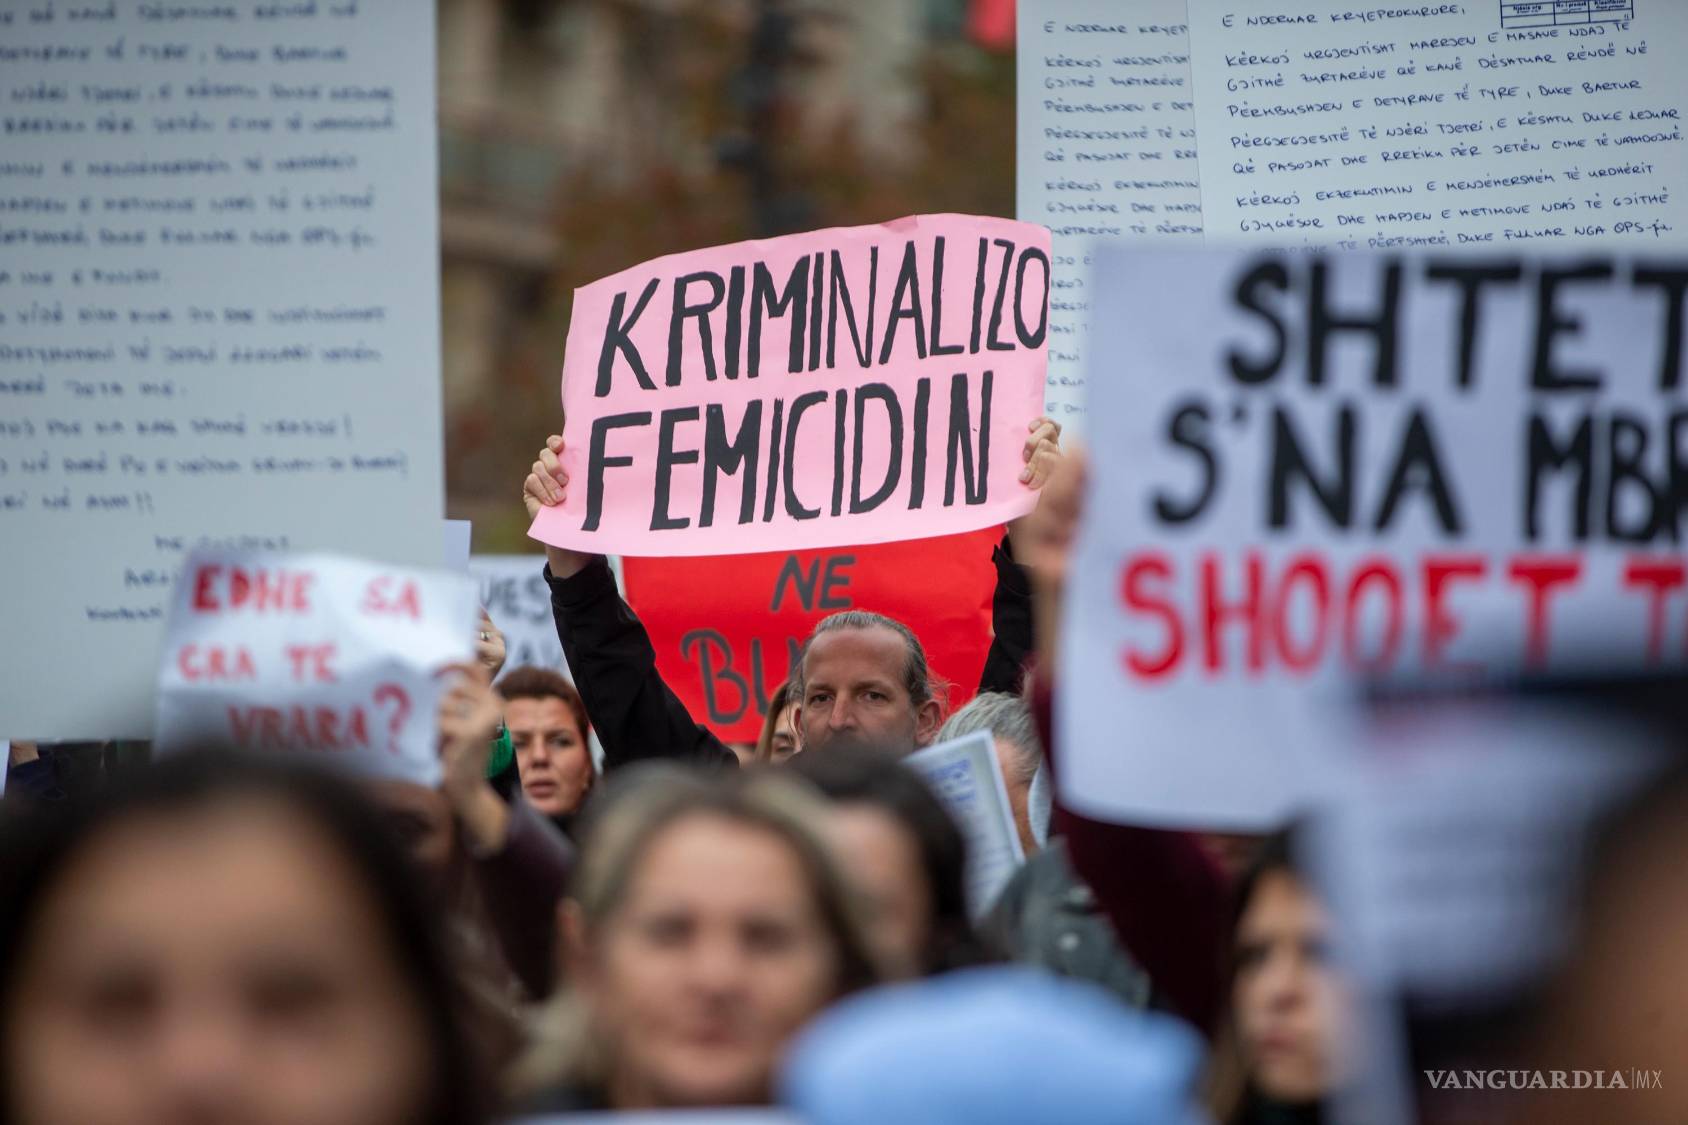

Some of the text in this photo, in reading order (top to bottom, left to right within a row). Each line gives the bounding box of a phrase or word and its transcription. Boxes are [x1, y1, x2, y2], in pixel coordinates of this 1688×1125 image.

[1221, 14, 1235, 28] E
[1488, 31, 1499, 43] E
[1352, 99, 1364, 109] E
[1497, 117, 1507, 129] E
[1426, 180, 1437, 192] E
[1441, 209, 1451, 220] E
[593, 235, 1051, 398] KRIMINALIZO
[580, 369, 994, 532] FEMICIDIN
[768, 553, 857, 613] NE
[190, 564, 317, 614] EDHE
[361, 575, 424, 622] SA
